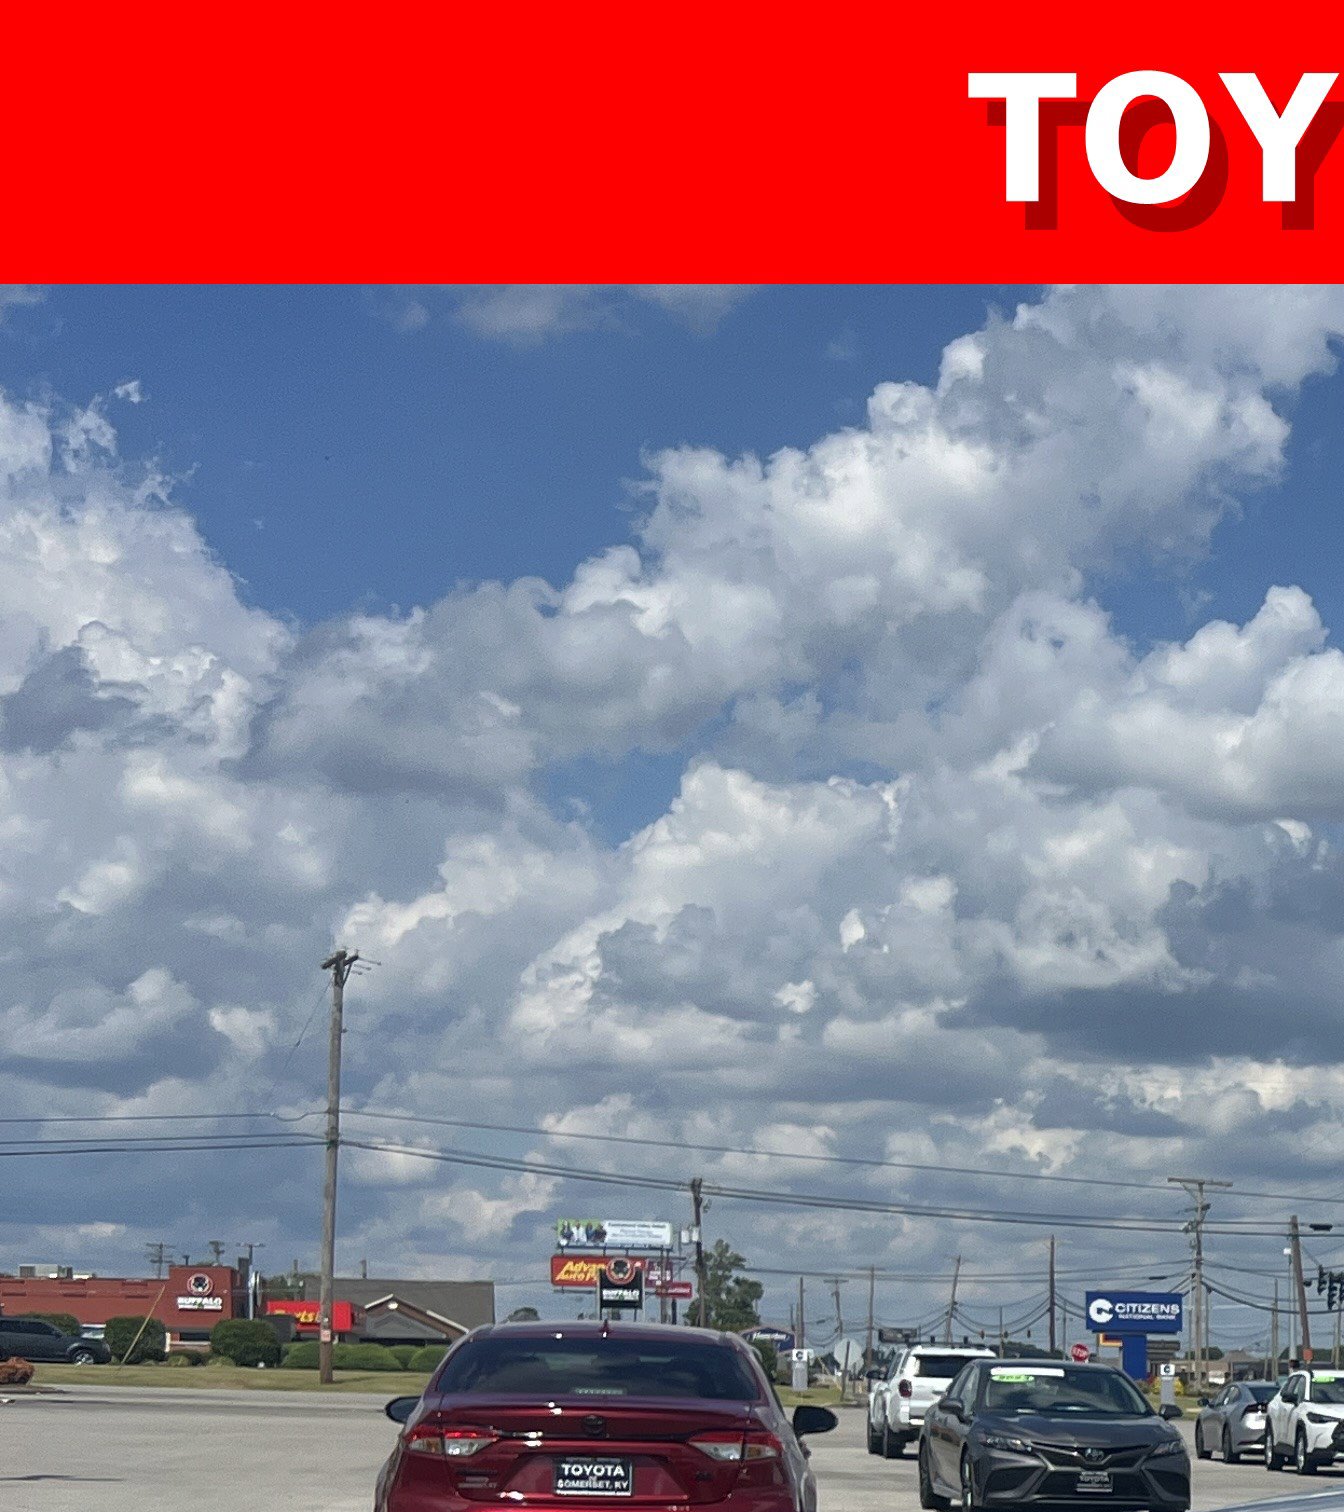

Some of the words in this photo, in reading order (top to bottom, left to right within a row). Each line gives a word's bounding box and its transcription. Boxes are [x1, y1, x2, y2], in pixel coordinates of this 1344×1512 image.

[1115, 1302, 1180, 1314] CITIZENS
[561, 1463, 625, 1477] TOYOTA
[557, 1478, 613, 1489] SOMERSET,
